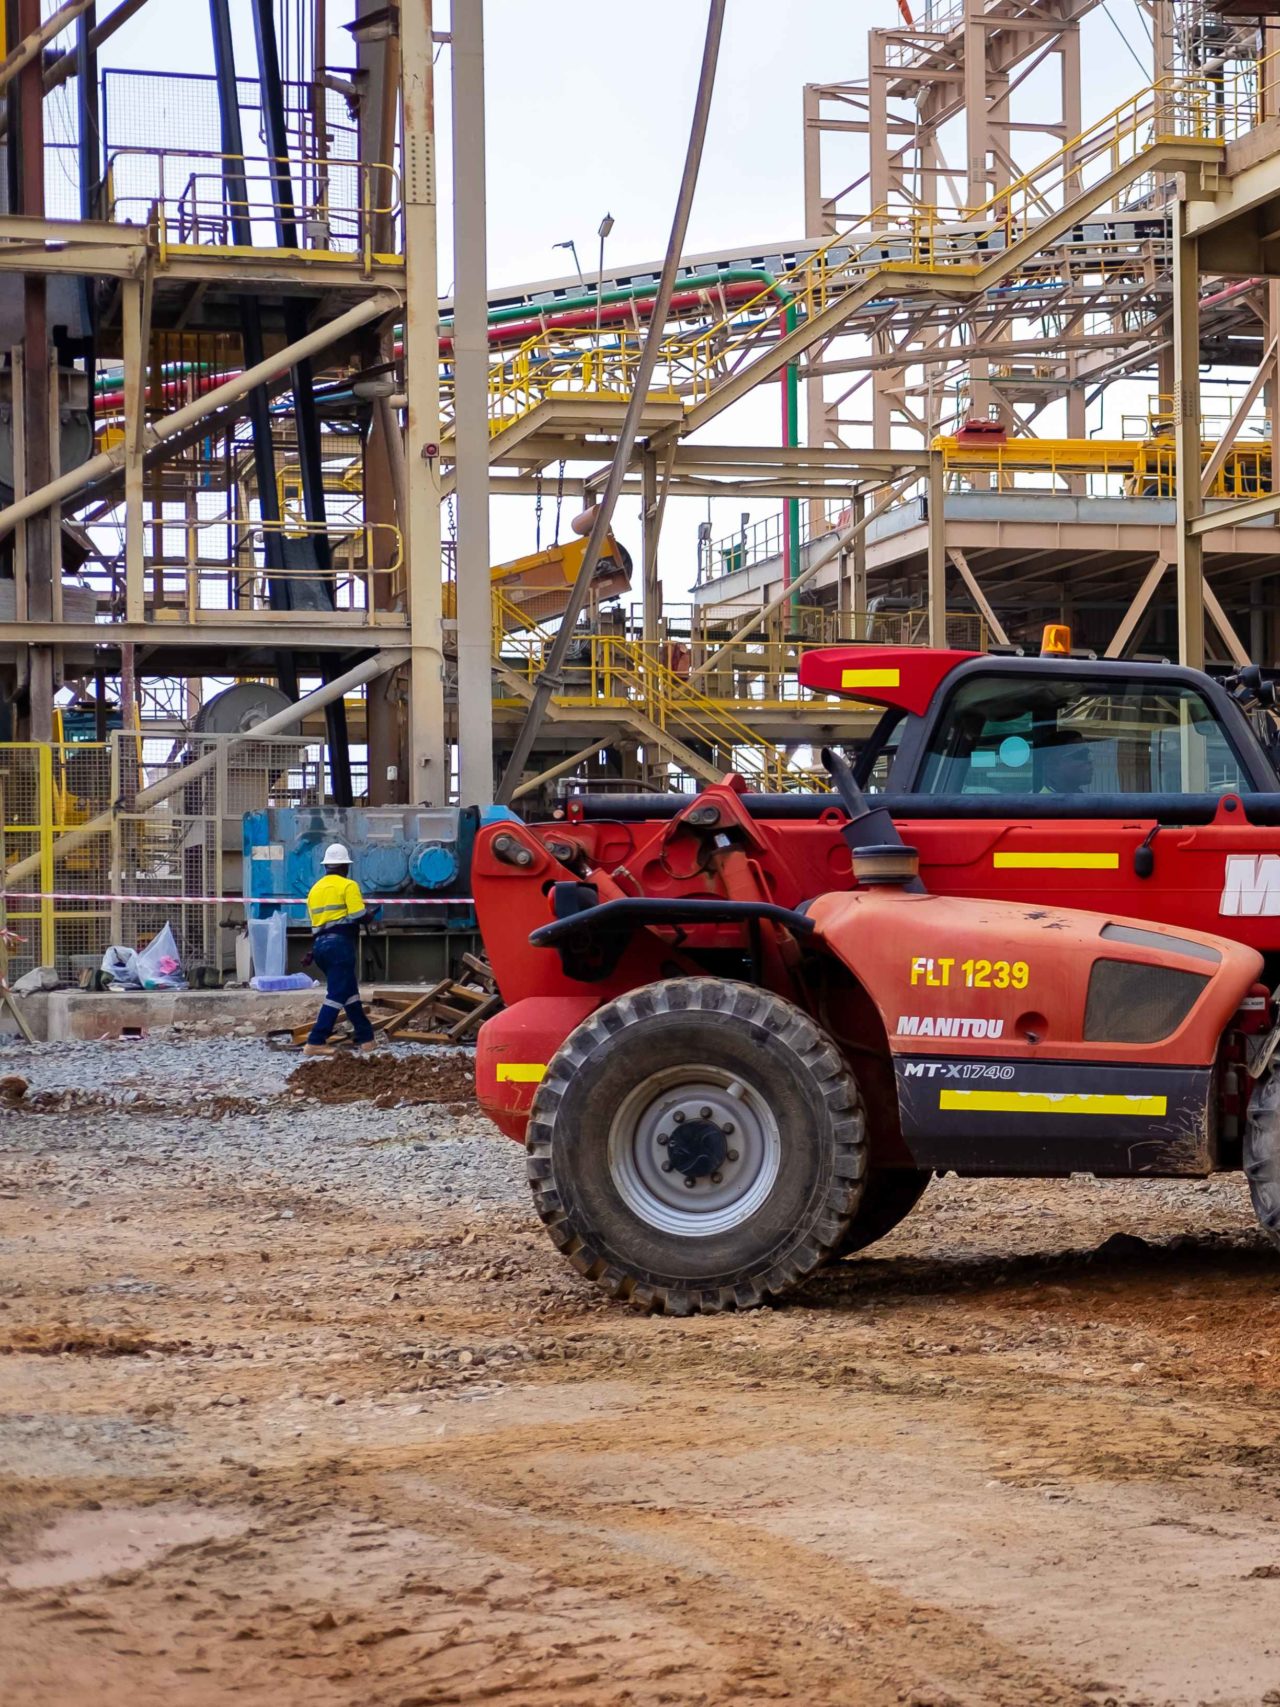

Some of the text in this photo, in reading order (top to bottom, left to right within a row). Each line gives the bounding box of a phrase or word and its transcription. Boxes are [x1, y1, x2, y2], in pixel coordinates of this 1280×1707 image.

[910, 957, 1029, 989] FLT 1239
[896, 1016, 1003, 1039] MANITOU
[904, 1063, 1015, 1080] MT-X1740
